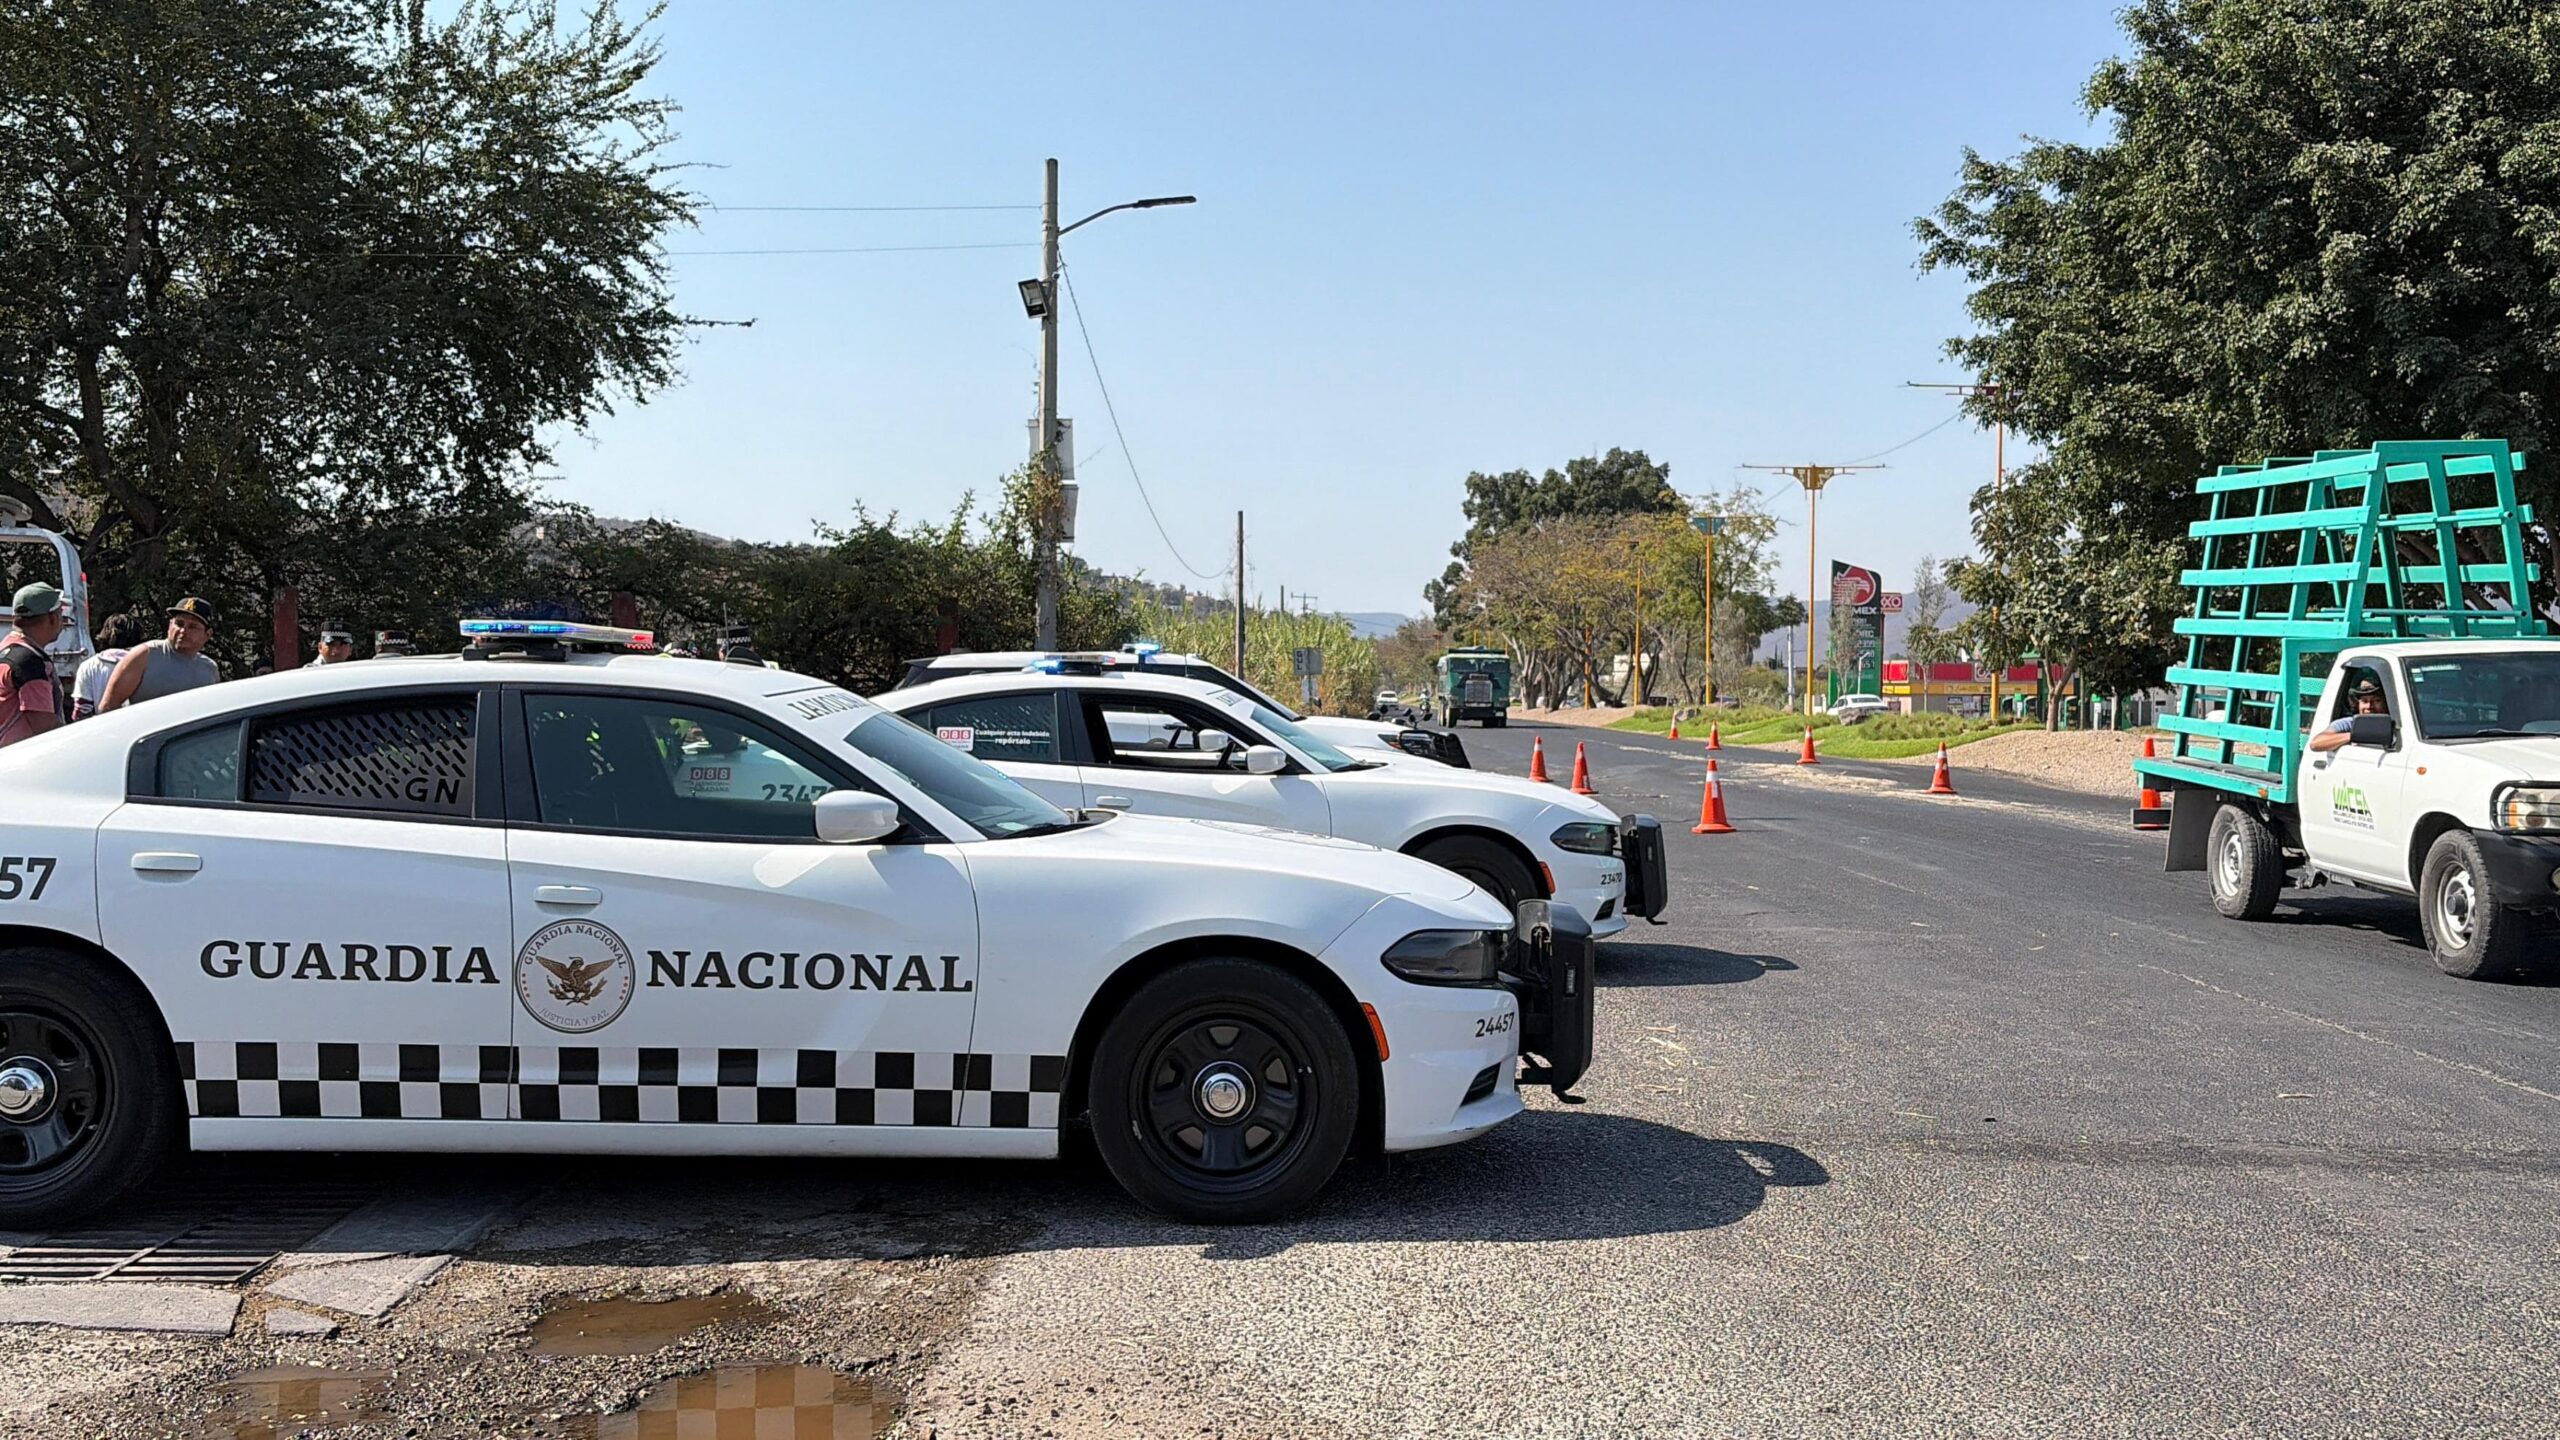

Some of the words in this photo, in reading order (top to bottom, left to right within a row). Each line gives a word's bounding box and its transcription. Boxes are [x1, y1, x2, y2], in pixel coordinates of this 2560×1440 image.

[1851, 606, 1877, 615] MEX
[995, 737, 1031, 745] repórtalo
[693, 768, 728, 779] 088
[405, 777, 460, 804] GN
[762, 784, 836, 802] 2347
[524, 925, 573, 965] GUARDIA
[576, 924, 626, 969] NACIONAL
[200, 940, 500, 984] GUARDIA
[646, 950, 973, 992] NACIONAL
[539, 1008, 581, 1026] JUSTICIA
[591, 1009, 610, 1024] PAZ
[1475, 1011, 1515, 1038] 24457
